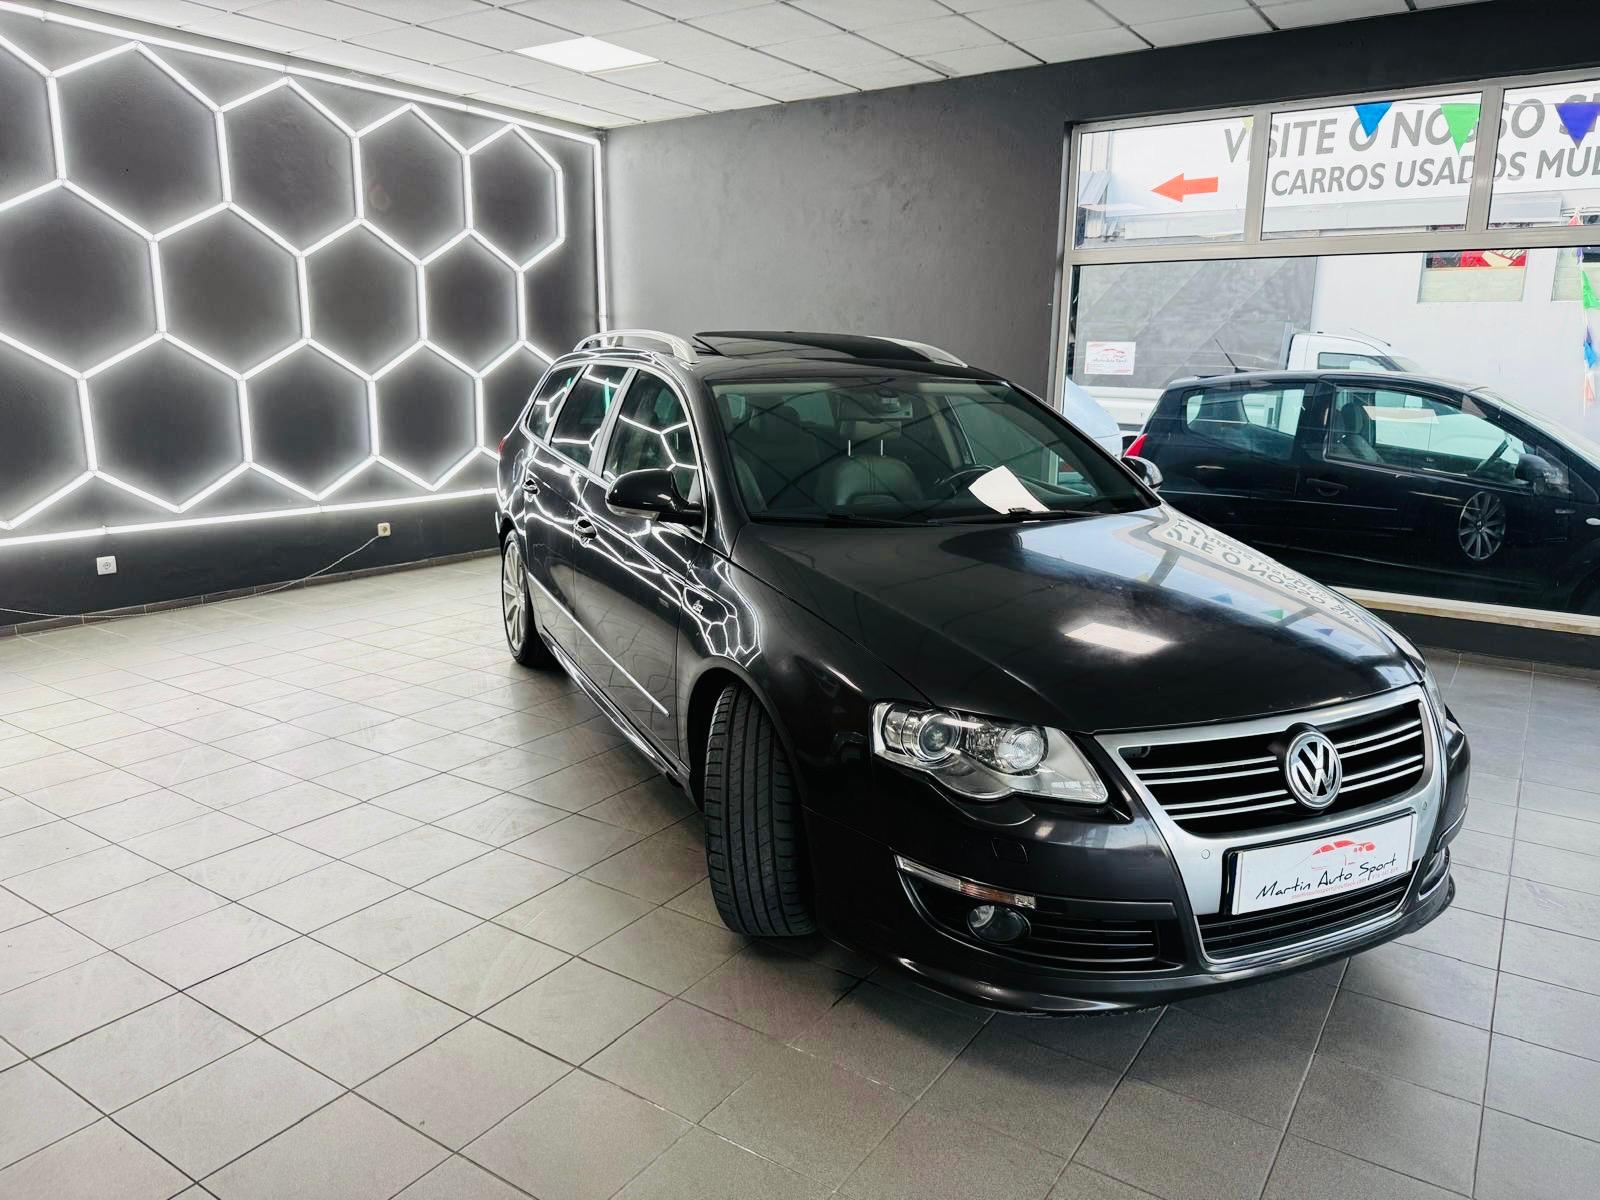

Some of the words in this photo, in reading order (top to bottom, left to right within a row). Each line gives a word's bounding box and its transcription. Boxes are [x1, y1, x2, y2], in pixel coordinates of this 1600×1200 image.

[1224, 118, 1338, 163] VSITE
[1391, 98, 1546, 149] NOO
[1271, 162, 1386, 196] CARROS
[1289, 736, 1338, 801] VW
[1255, 876, 1311, 900] Martin
[1317, 867, 1353, 888] Auto
[1359, 852, 1397, 880] Sport
